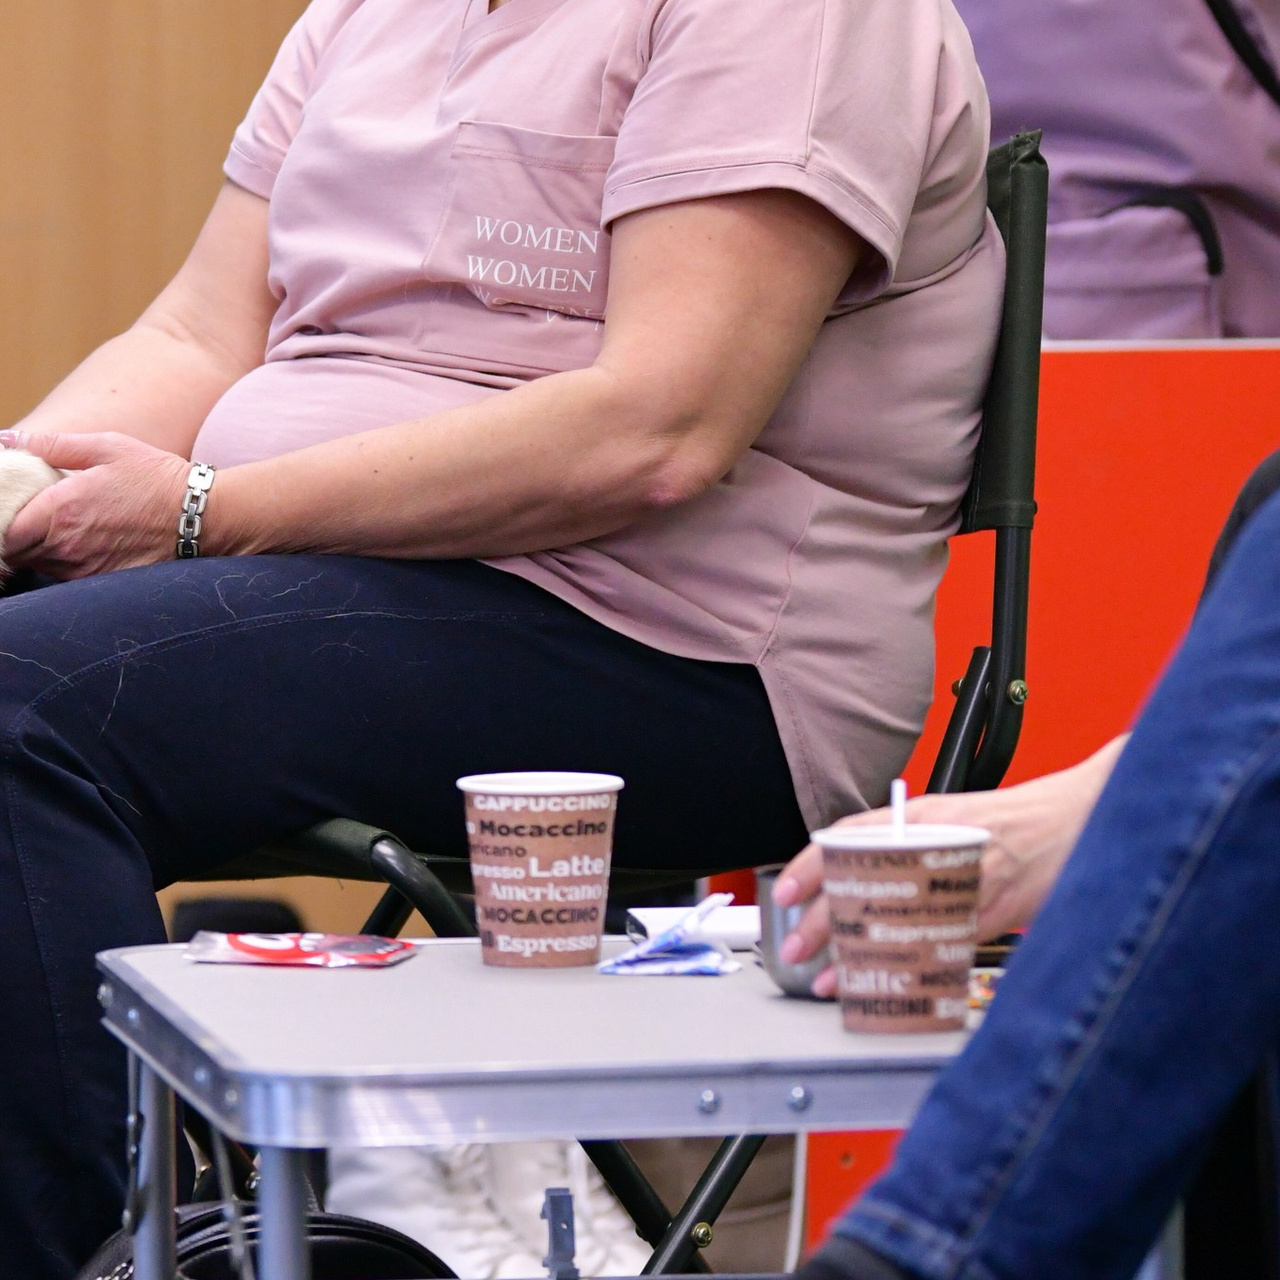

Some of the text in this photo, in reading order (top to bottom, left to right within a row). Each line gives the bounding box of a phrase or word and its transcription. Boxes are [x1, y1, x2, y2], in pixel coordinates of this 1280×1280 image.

[475, 215, 599, 254] WOMEN
[466, 255, 596, 292] WOMEN
[473, 794, 611, 813] CAPPUCCINO
[480, 820, 607, 837] Mocaccino
[529, 854, 605, 878] Latte
[490, 882, 602, 902] Americano
[484, 907, 599, 924] MOCACCINO
[496, 934, 597, 957] Espresso
